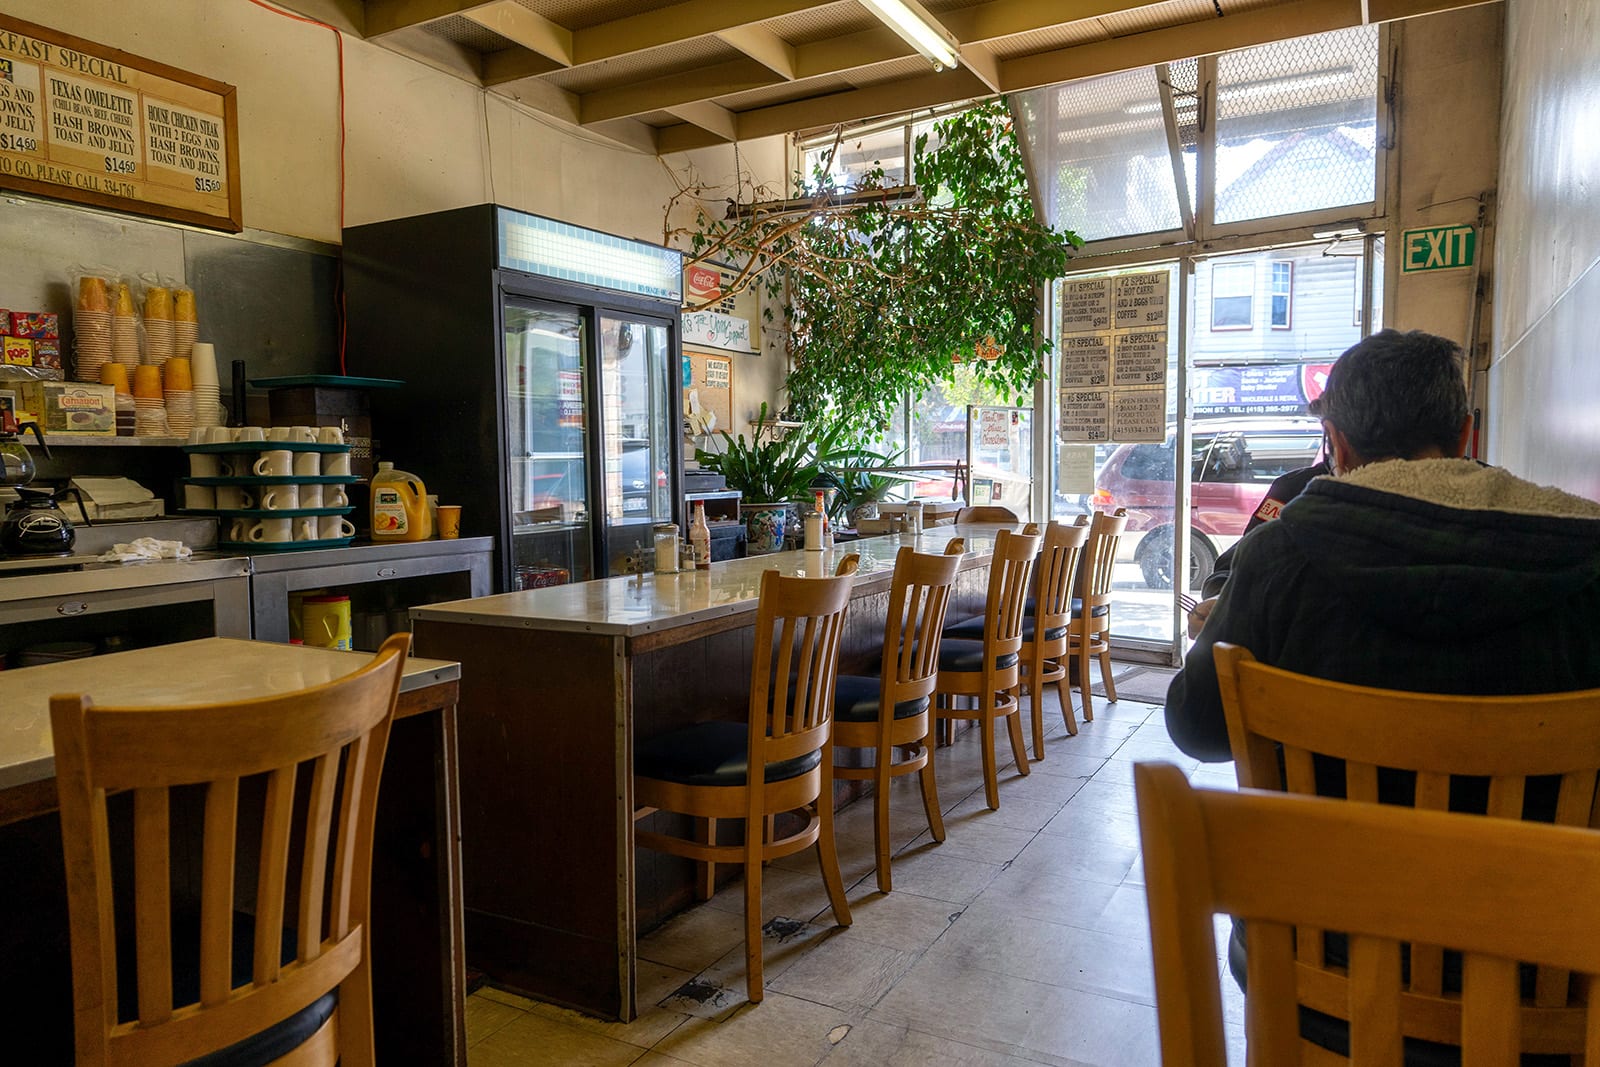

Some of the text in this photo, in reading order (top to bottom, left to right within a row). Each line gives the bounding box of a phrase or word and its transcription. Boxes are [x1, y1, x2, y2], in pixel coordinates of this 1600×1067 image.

[60, 48, 127, 84] SPECIAL
[14, 88, 34, 103] AND
[50, 78, 133, 115] TEXAS OMELETTE
[5, 115, 35, 132] JELLY
[53, 98, 71, 111] (CHILI
[111, 112, 133, 128] CHEESE)
[148, 105, 219, 138] HOUSE CHICKEN STEAK
[54, 112, 134, 143] HASH BROWNS,
[54, 126, 135, 156] TOAST AND JELLY
[150, 122, 219, 151] WITH 2 EGGS AND
[151, 136, 220, 164] HASH BROWNS,
[151, 149, 220, 176] TOAST AND JELLY
[37, 164, 72, 185] PLEASE
[76, 173, 100, 191] CALL
[104, 179, 136, 198] 334-1761
[1406, 227, 1473, 269] EXIT
[1079, 281, 1105, 292] SPECIAL
[1131, 274, 1159, 285] SPECIAL
[1117, 310, 1137, 319] COFFEE
[1077, 337, 1103, 347] SPECIAL
[1130, 334, 1159, 344] SPECIAL
[7, 348, 30, 361] POPS
[1076, 392, 1102, 402] SPECIAL
